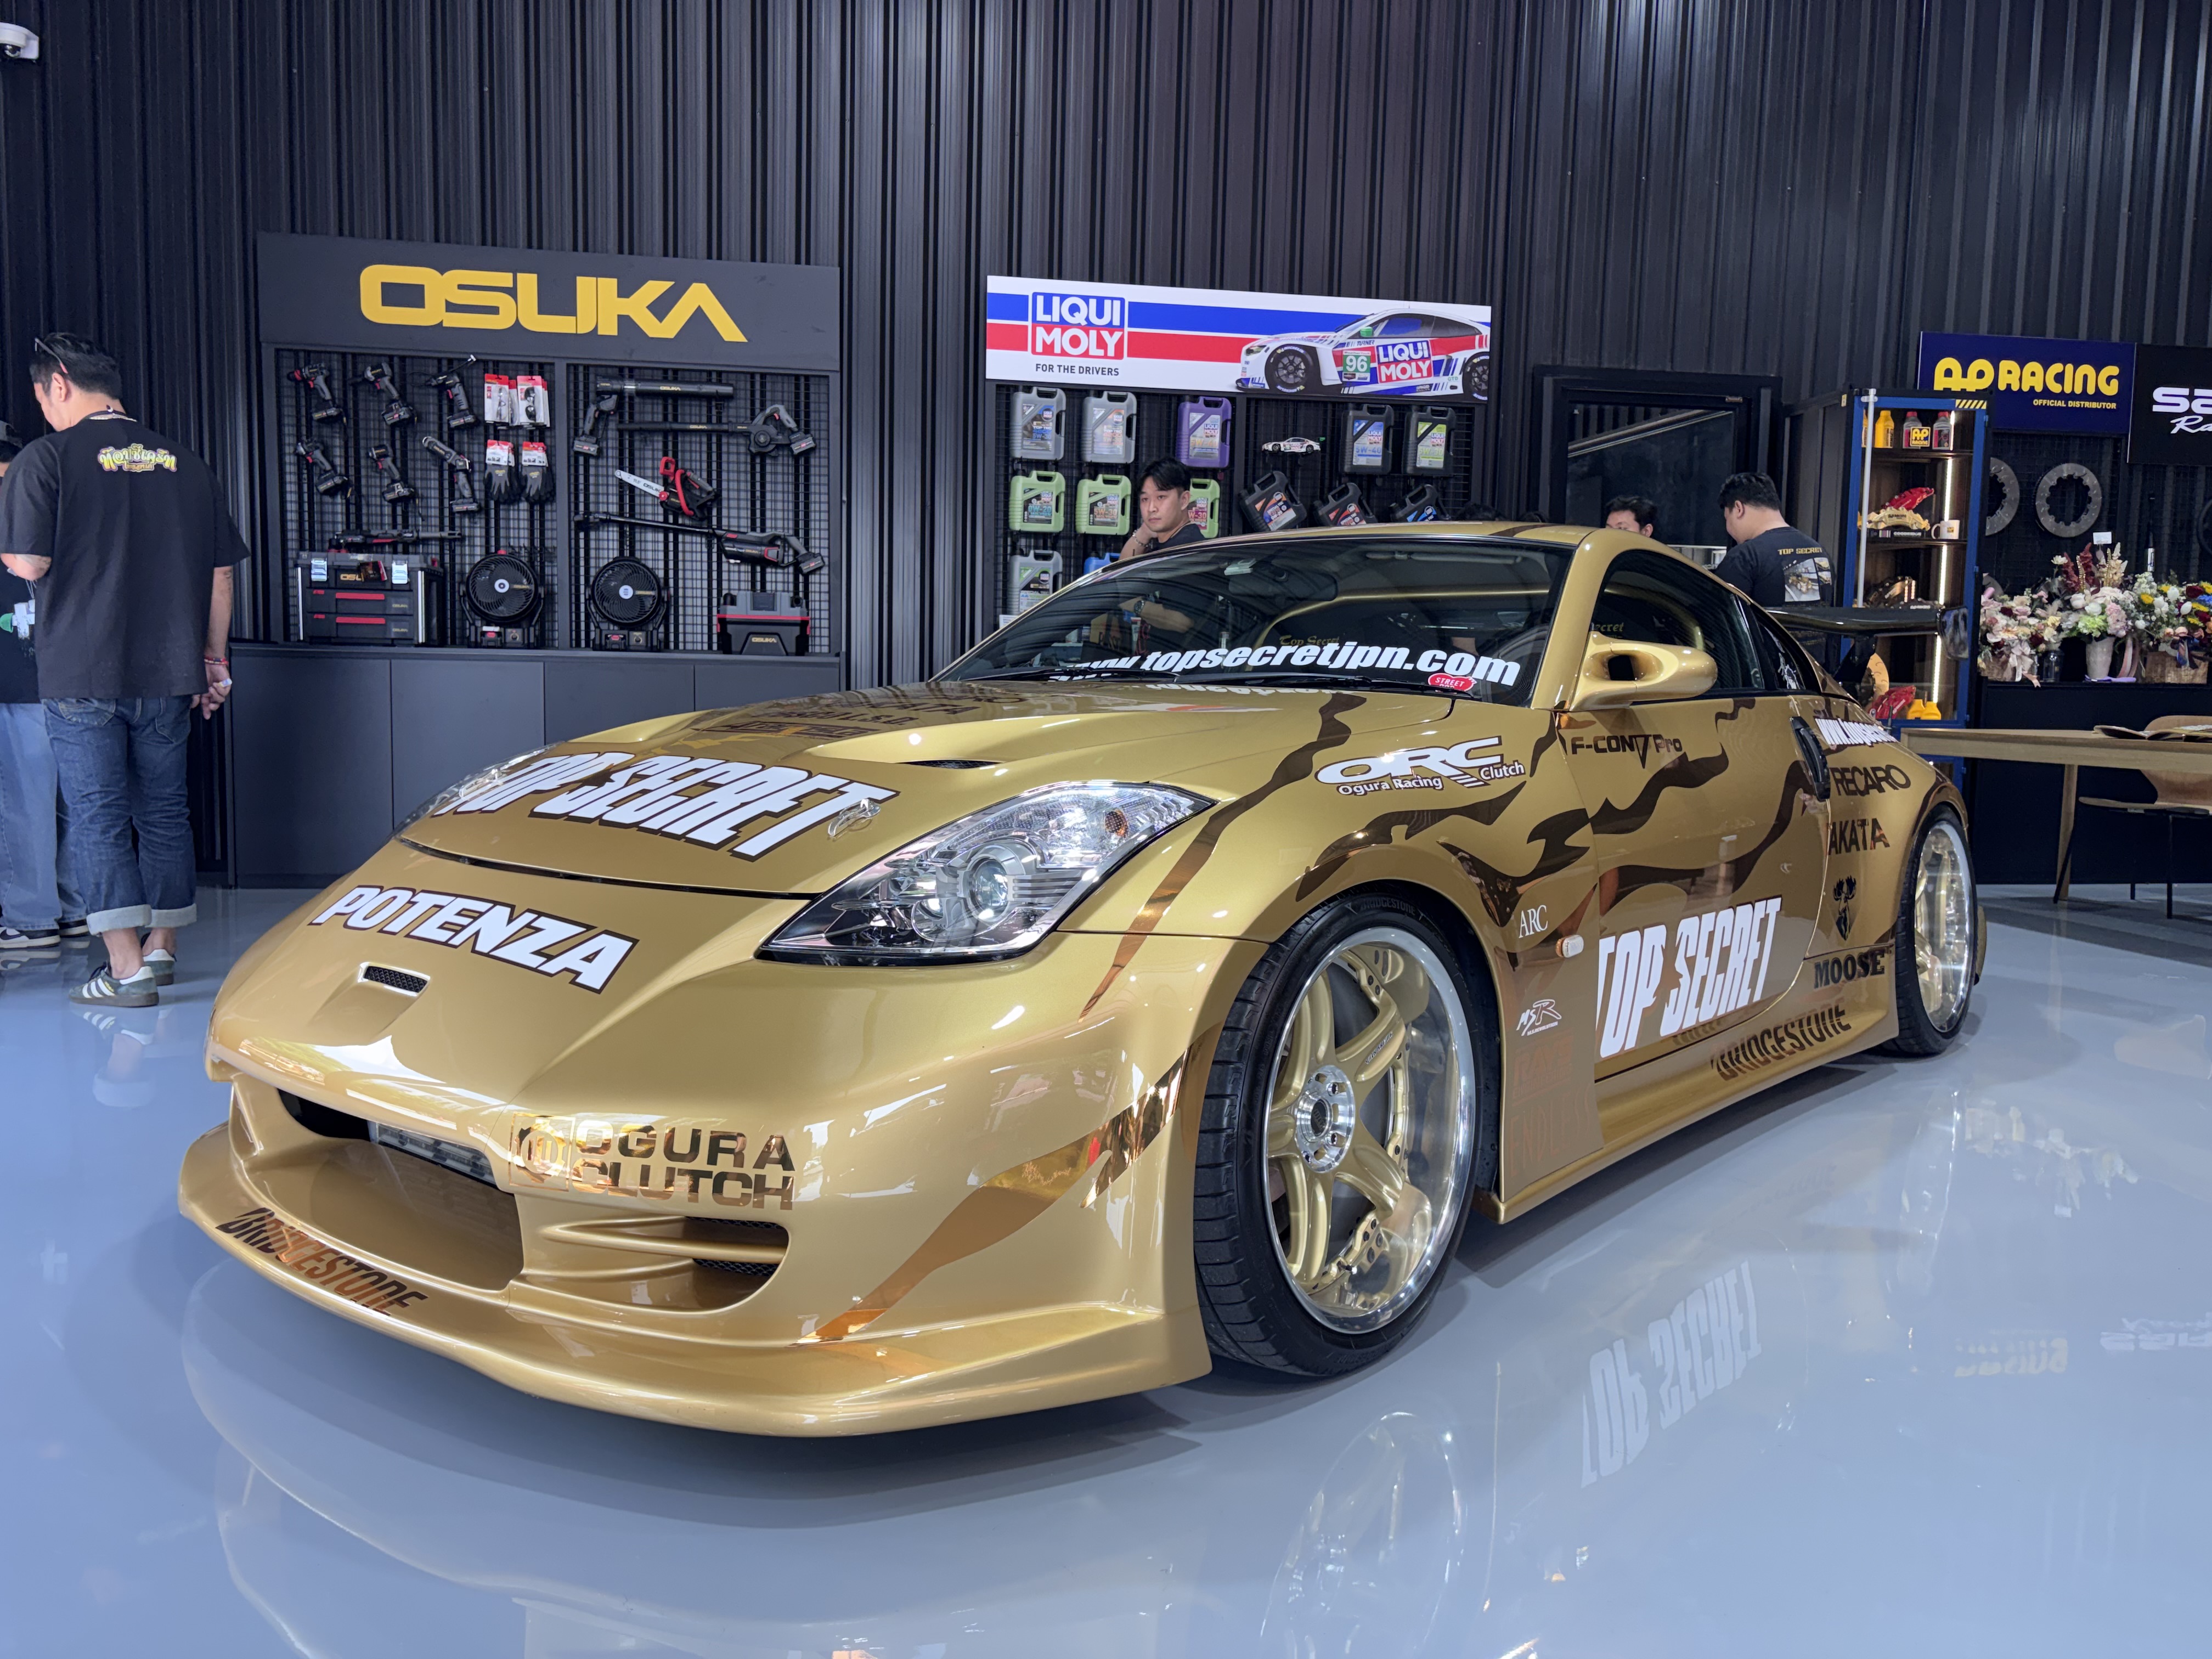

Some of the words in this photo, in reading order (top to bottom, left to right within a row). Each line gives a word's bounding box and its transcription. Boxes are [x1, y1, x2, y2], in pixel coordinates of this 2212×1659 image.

[360, 264, 748, 342] OSUKA
[1036, 295, 1121, 326] LIQUI
[1035, 327, 1124, 357] MOLY
[1378, 341, 1429, 363] LIQUI
[1035, 363, 1054, 373] FOR
[1057, 364, 1076, 375] THE
[1078, 365, 1119, 376] DRIVERS
[1346, 356, 1368, 372] 96
[1380, 360, 1431, 382] MOLY
[1934, 357, 1995, 392] AP
[1998, 360, 2120, 396] RACING
[2033, 399, 2067, 408] OFFICIAL
[2068, 400, 2117, 409] DISTRIBUTOR
[644, 483, 661, 492] OSUK
[1188, 510, 1207, 519] W-30
[1048, 641, 1521, 686] wwwtopsecretjpn.com
[1435, 677, 1465, 687] STREET
[1656, 734, 1683, 752] Pro
[1316, 736, 1504, 788] ORC
[1338, 780, 1390, 796] Ogura
[1392, 776, 1443, 791] Racing
[1480, 762, 1525, 780] Clutch
[433, 752, 635, 816] TOP
[1832, 764, 1911, 796] RECARO
[530, 755, 900, 862] SECRET
[310, 883, 639, 994] POTENZA
[1518, 905, 1548, 938] ARC
[1595, 924, 1666, 1058] TOP
[1660, 896, 1782, 1037] SECRET
[1814, 950, 1885, 989] MOOSE
[1711, 997, 1852, 1081] BRIDGESTONE
[576, 1121, 795, 1171] OGURA
[573, 1158, 793, 1210] CLUTCH
[215, 1207, 428, 1316] BRIDGESTONE
